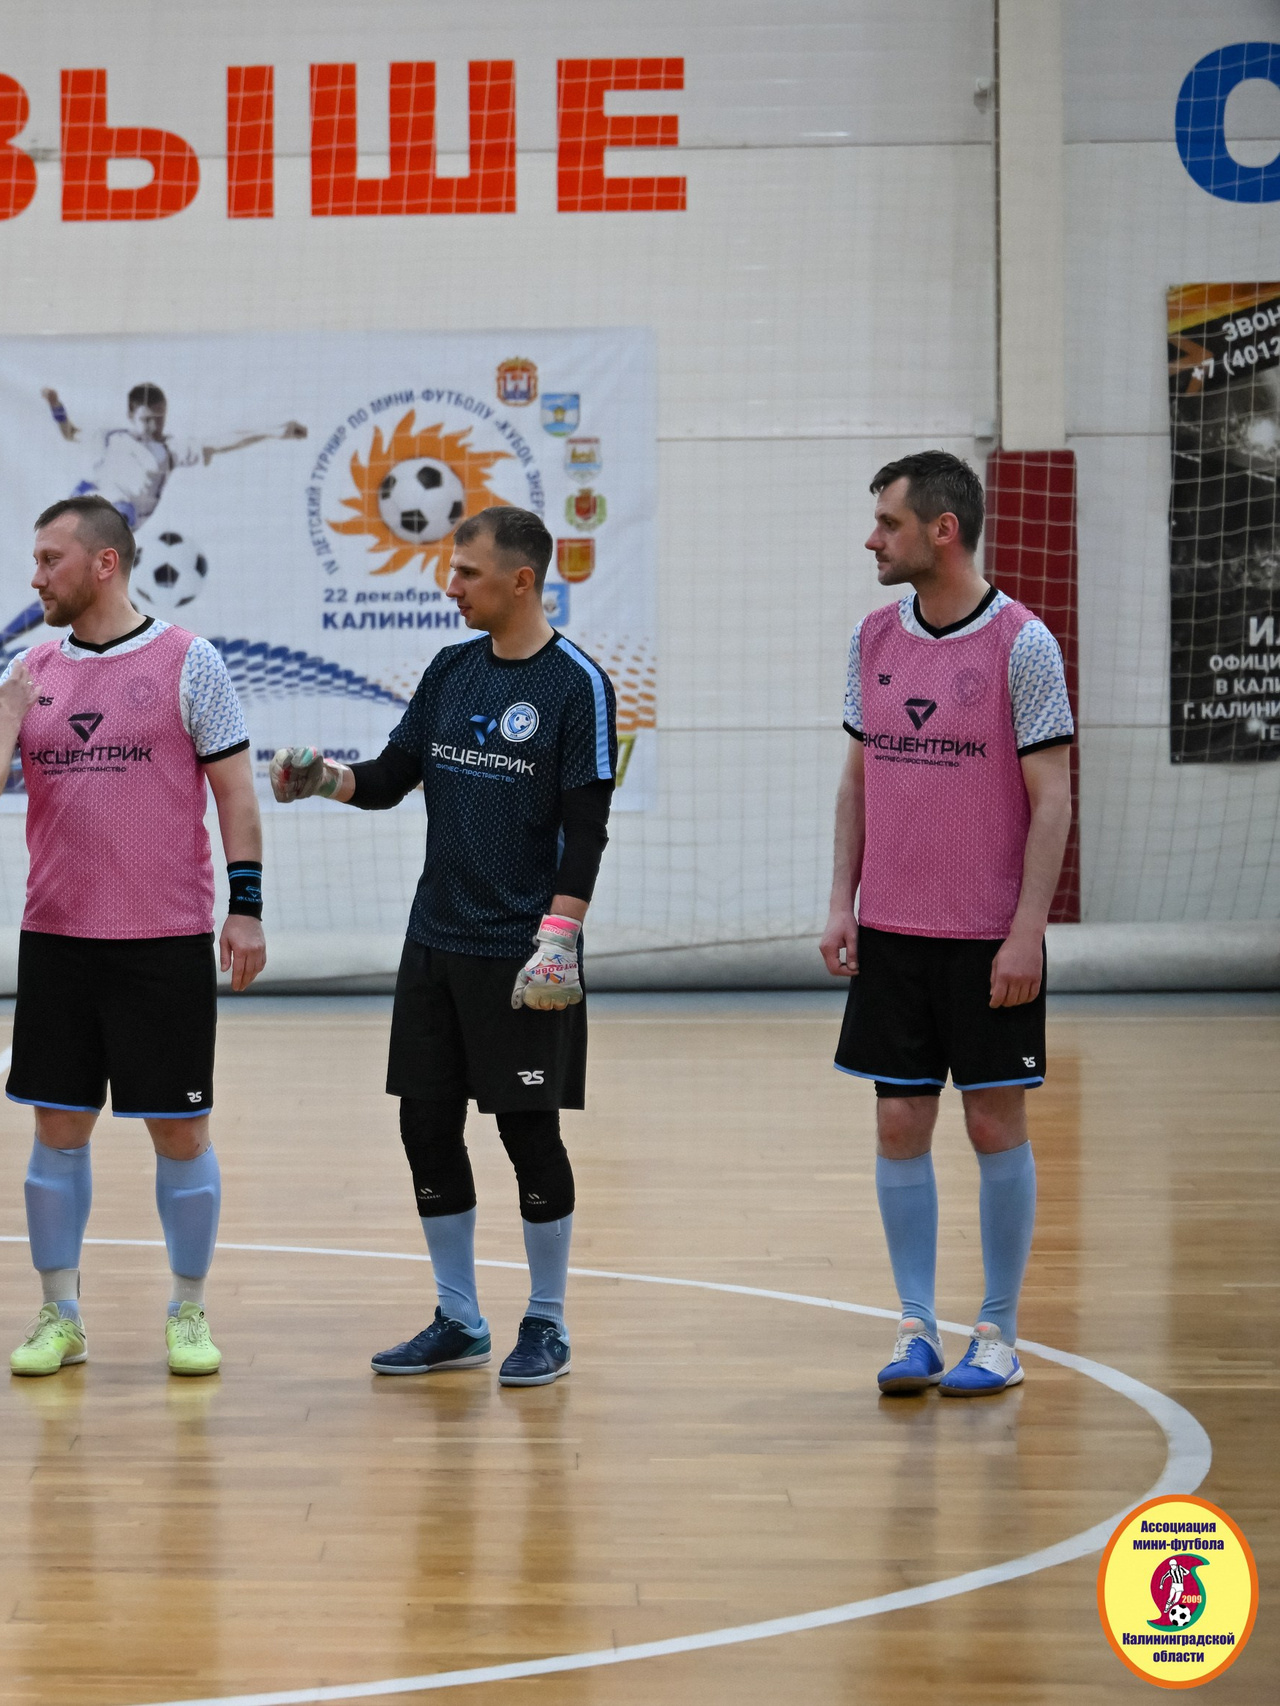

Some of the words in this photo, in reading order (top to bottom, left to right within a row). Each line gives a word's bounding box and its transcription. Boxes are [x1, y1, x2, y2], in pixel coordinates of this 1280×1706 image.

[310, 425, 347, 480] ТУРНИР
[347, 407, 369, 430] ПО
[369, 389, 415, 415] МИНИ
[421, 389, 494, 420] ФУТБОЛУ
[324, 588, 347, 603] 22
[354, 586, 442, 606] декабря
[322, 611, 461, 630] КАЛИНИНГ
[1216, 678, 1229, 695] В
[431, 742, 536, 776] ЭКСЦЕНТРИК
